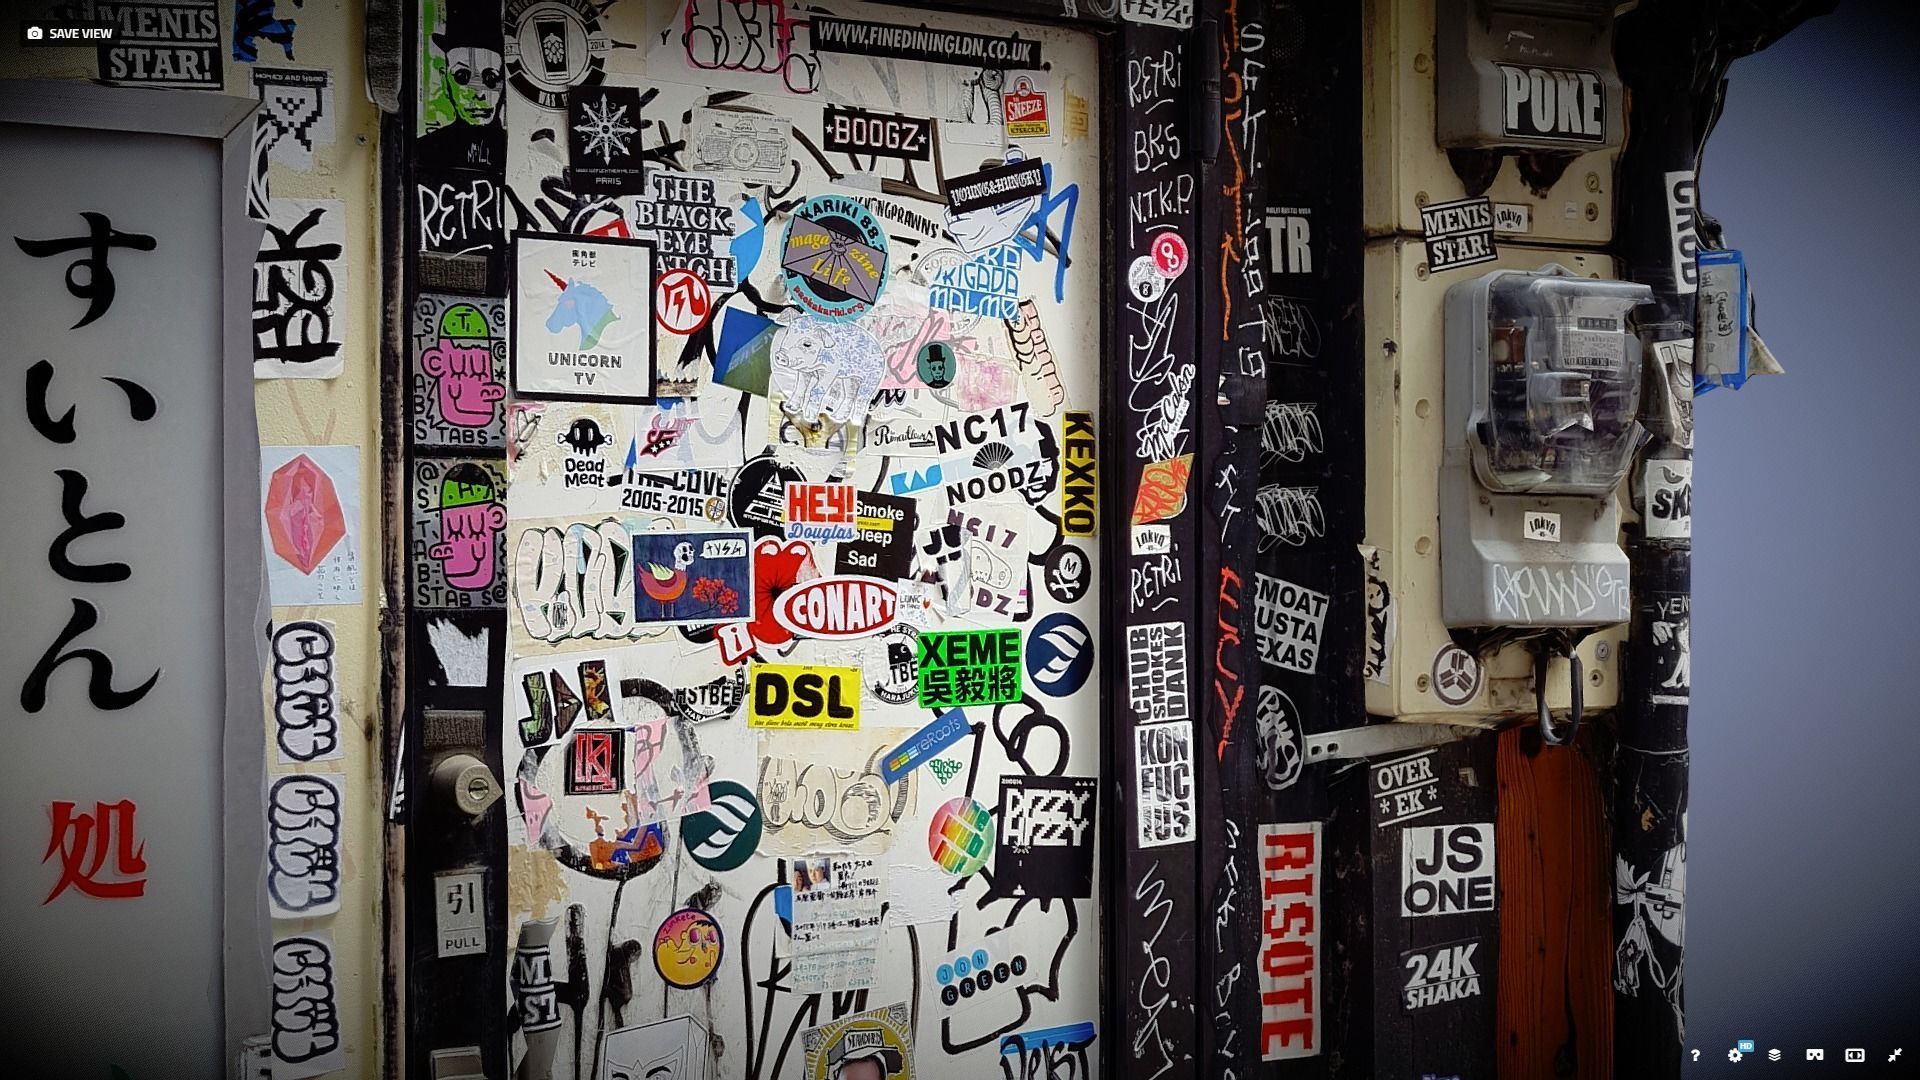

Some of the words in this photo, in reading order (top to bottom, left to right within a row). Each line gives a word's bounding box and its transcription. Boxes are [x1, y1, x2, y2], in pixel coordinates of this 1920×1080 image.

[818, 21, 1031, 62] WWW.FINEDININGLDN.CO.UK
[110, 45, 212, 80] STAR!
[1502, 66, 1601, 136] POKE
[834, 115, 919, 151] BOOGZ
[596, 177, 622, 186] PARIS
[655, 176, 712, 203] THE
[637, 201, 731, 231] BLACK
[1425, 203, 1491, 236] MENIS
[657, 233, 709, 255] EYE
[790, 232, 831, 250] maga
[849, 248, 879, 279] zine
[1265, 216, 1312, 273] TR
[1432, 232, 1491, 266] STAR!
[549, 353, 622, 369] UNICORN
[574, 372, 596, 385] TV
[935, 403, 1030, 454] NC17
[565, 458, 604, 474] Dead
[565, 473, 605, 488] Meat
[947, 461, 1046, 505] NOODZ
[622, 488, 705, 517] 2005-2015
[788, 484, 855, 522] HEY!
[856, 499, 905, 522] Smoke
[788, 522, 856, 545] Douglas
[847, 549, 877, 569] Sad
[792, 581, 897, 631] CONART
[919, 631, 1020, 668] XEME
[1150, 627, 1167, 720] SMOKES
[1164, 622, 1187, 718] DANK
[755, 672, 854, 719] DSL
[1377, 757, 1434, 791] OVER
[1415, 826, 1483, 876] JS
[447, 882, 474, 914] 引
[1404, 876, 1494, 914] ONE
[446, 937, 481, 950] PULL
[1263, 833, 1315, 1056] RISOTE
[939, 951, 986, 984] JON
[943, 957, 1025, 1004] GREEN
[1405, 943, 1480, 990] 24K
[1406, 976, 1481, 1011] SHAKA
